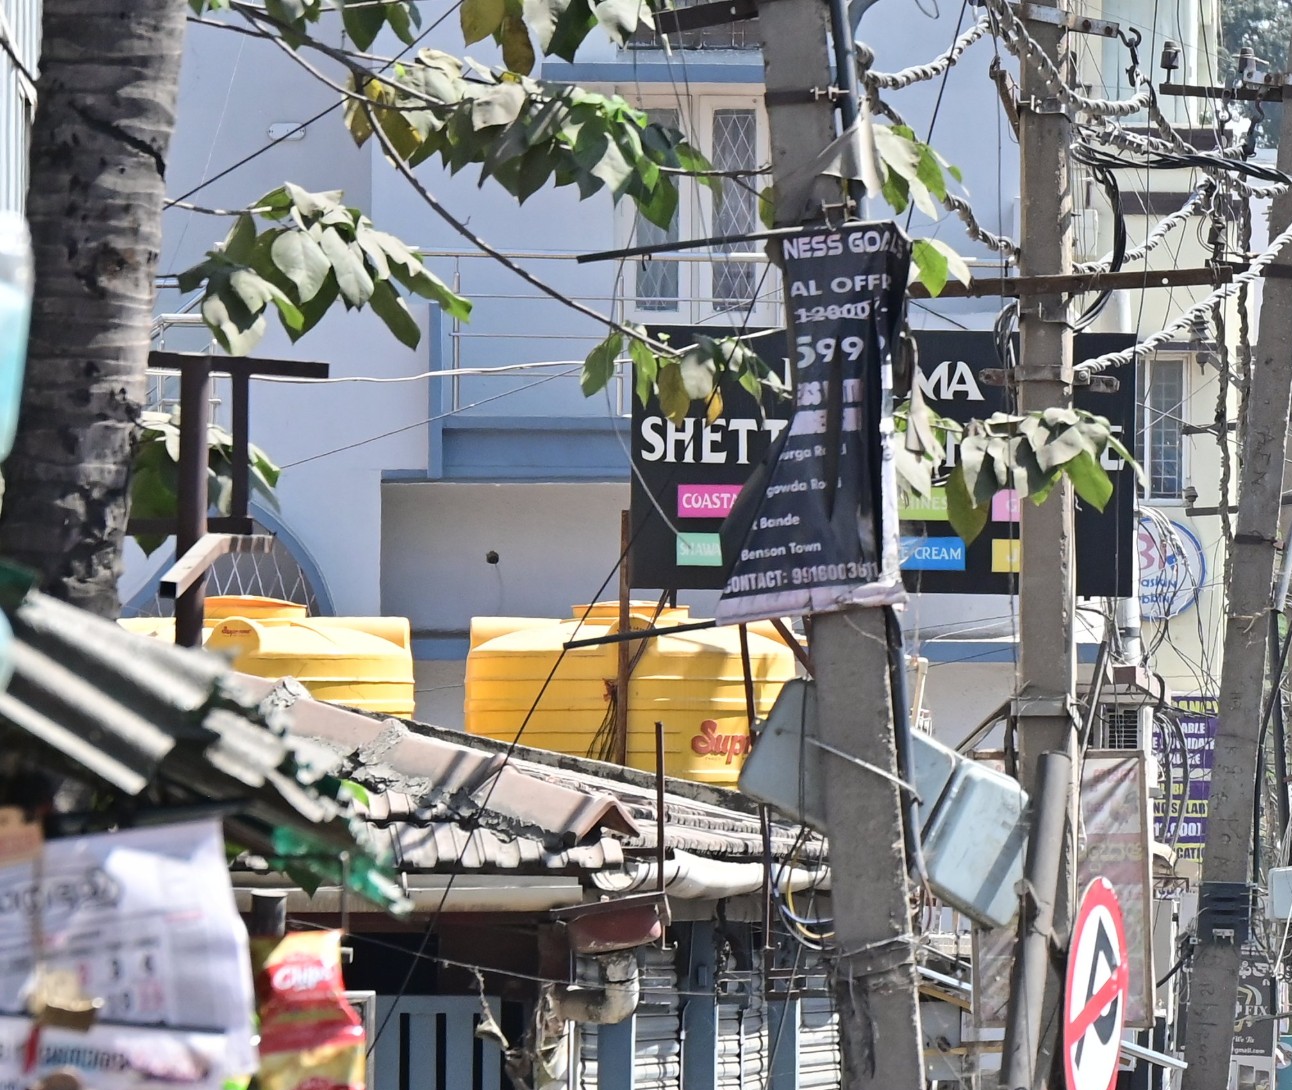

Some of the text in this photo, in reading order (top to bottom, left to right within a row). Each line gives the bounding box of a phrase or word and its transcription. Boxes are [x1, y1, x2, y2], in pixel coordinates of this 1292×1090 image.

[760, 513, 800, 528] Bande
[741, 541, 822, 562] Benson Town
[915, 547, 961, 560] CREAM
